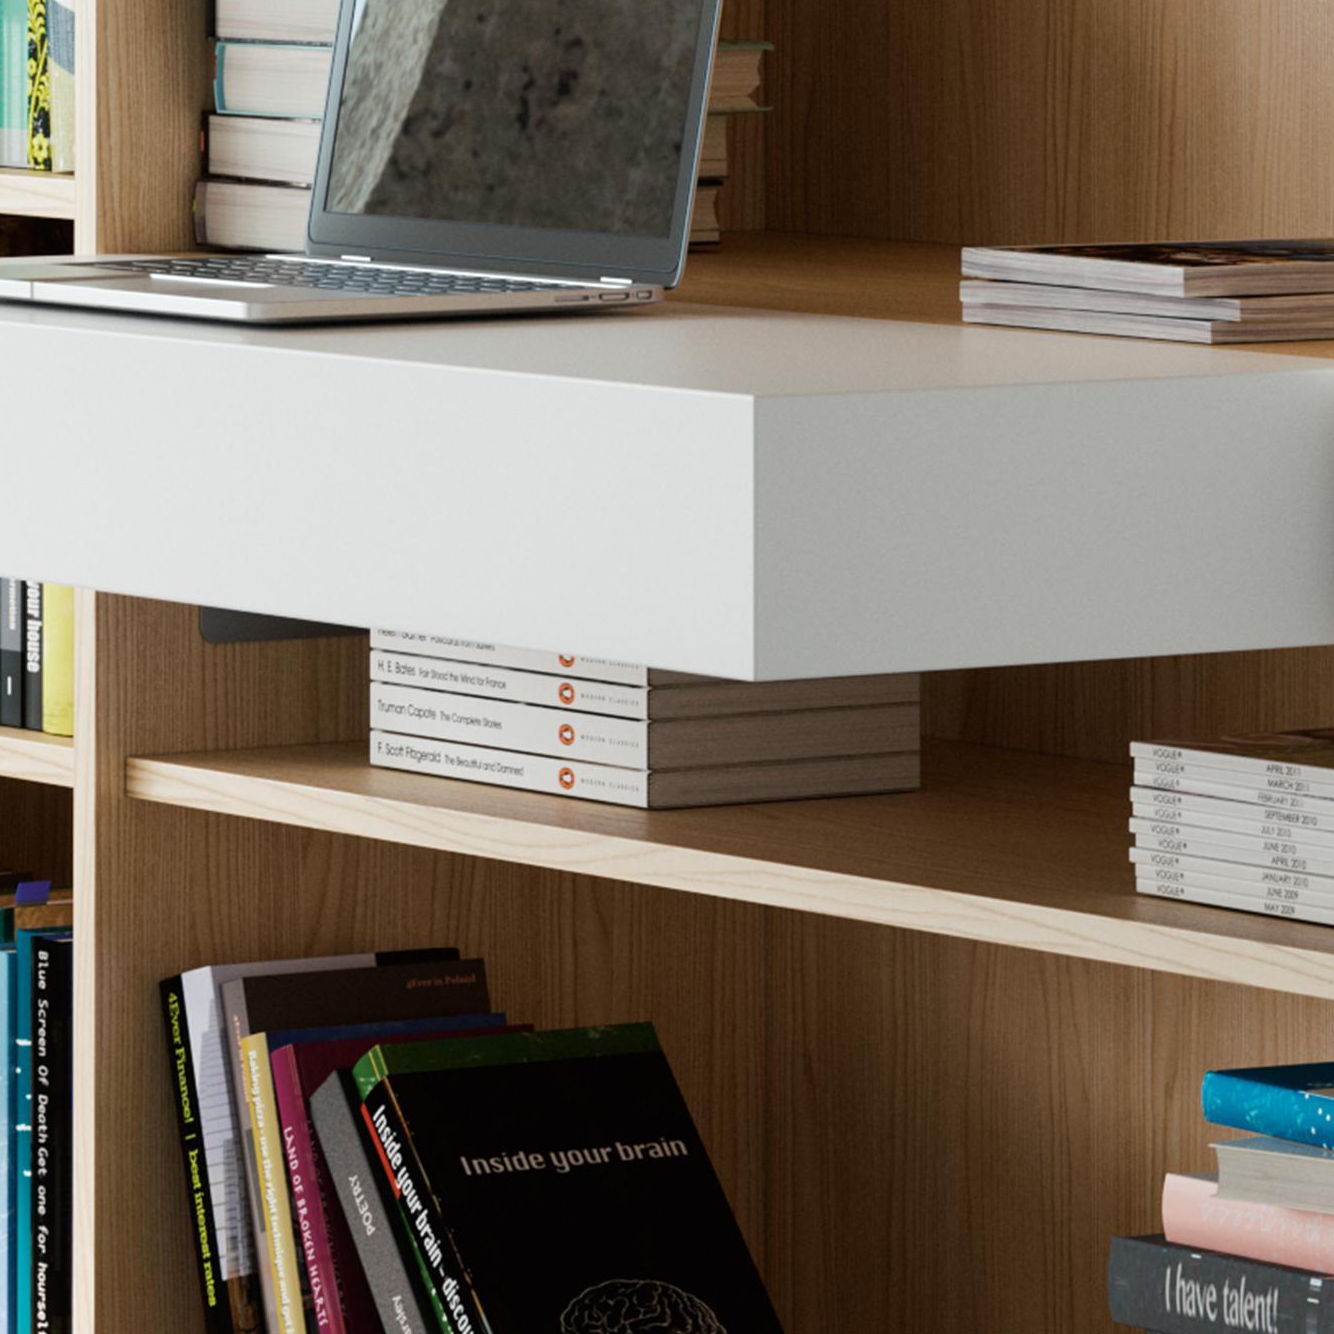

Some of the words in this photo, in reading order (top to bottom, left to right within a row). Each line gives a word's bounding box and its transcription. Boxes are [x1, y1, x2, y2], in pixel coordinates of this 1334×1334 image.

[385, 743, 404, 758] Scott
[371, 1104, 403, 1170] Inside
[395, 1167, 423, 1214] your
[414, 1209, 443, 1268] brain
[460, 1151, 547, 1176] Inside
[549, 1145, 613, 1174] your
[614, 1137, 688, 1162] brain
[348, 1174, 377, 1237] POETRY
[1165, 1265, 1172, 1314] I
[1175, 1262, 1218, 1323] have
